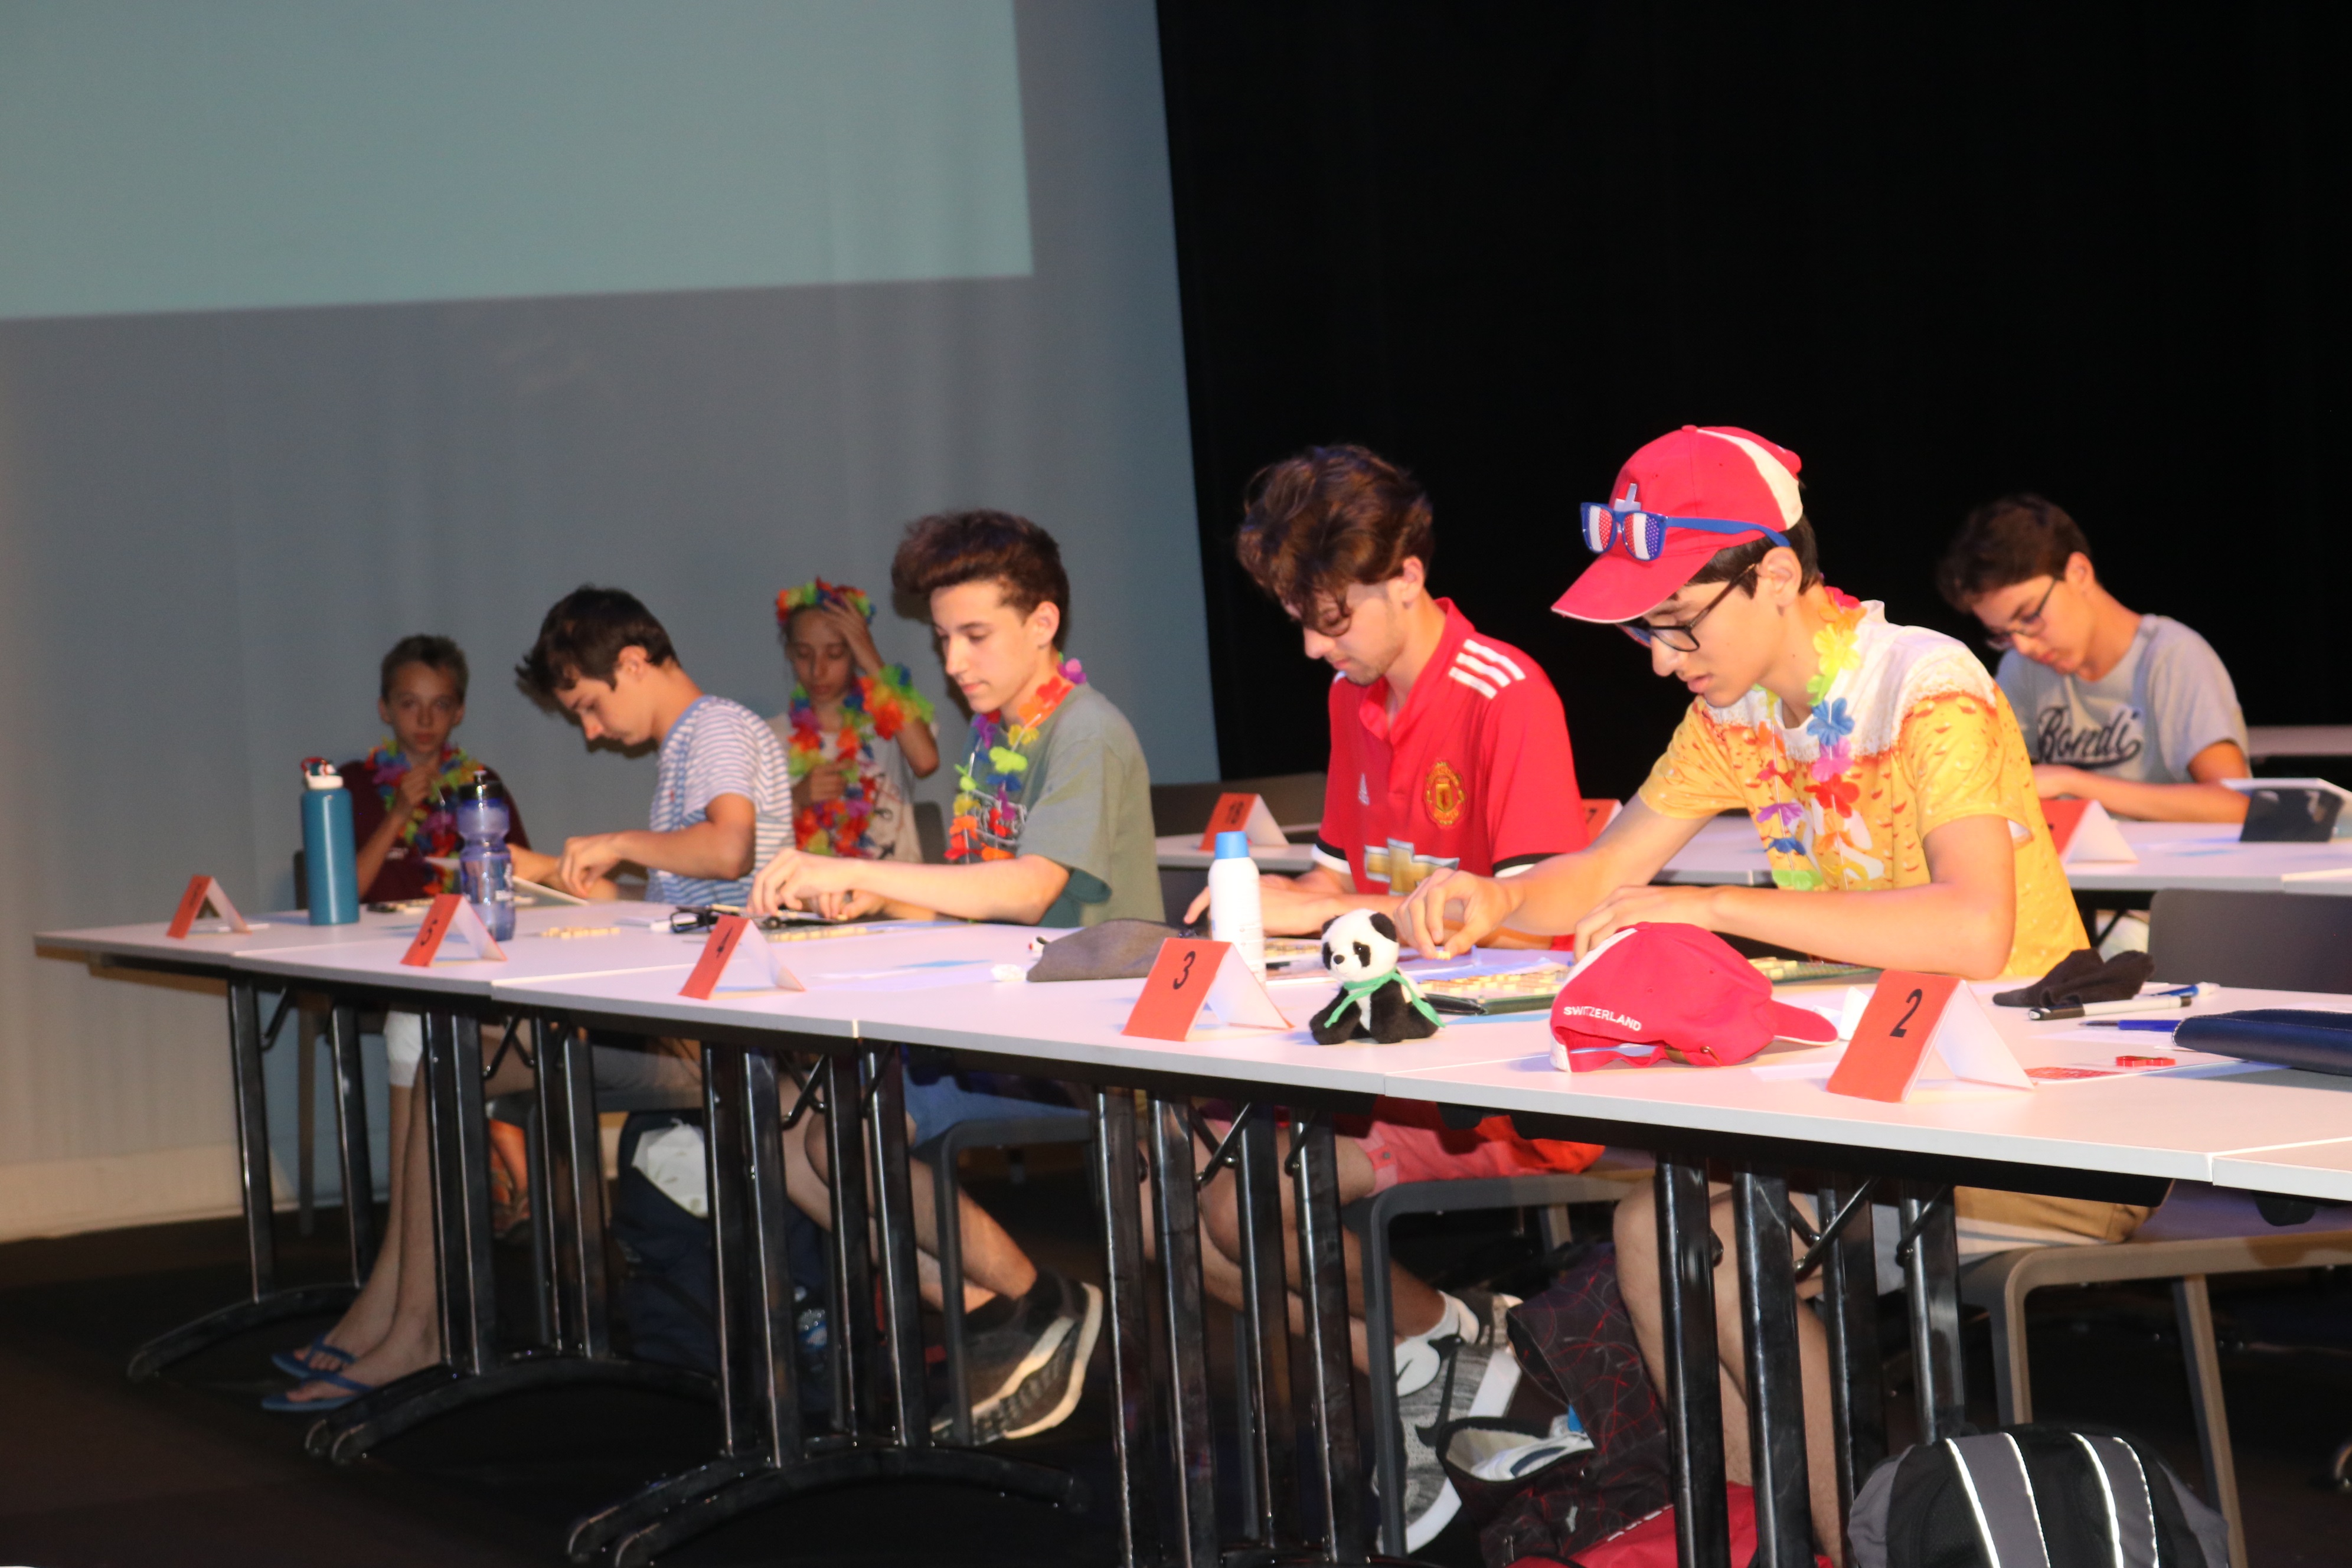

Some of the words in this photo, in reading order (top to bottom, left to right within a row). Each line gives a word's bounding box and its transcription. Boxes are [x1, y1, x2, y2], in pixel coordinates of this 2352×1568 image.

[420, 919, 438, 946] 5
[716, 926, 733, 959] 4
[1172, 950, 1196, 990] 3
[1563, 1005, 1642, 1031] SWITZERLAND
[1889, 988, 1923, 1038] 2
